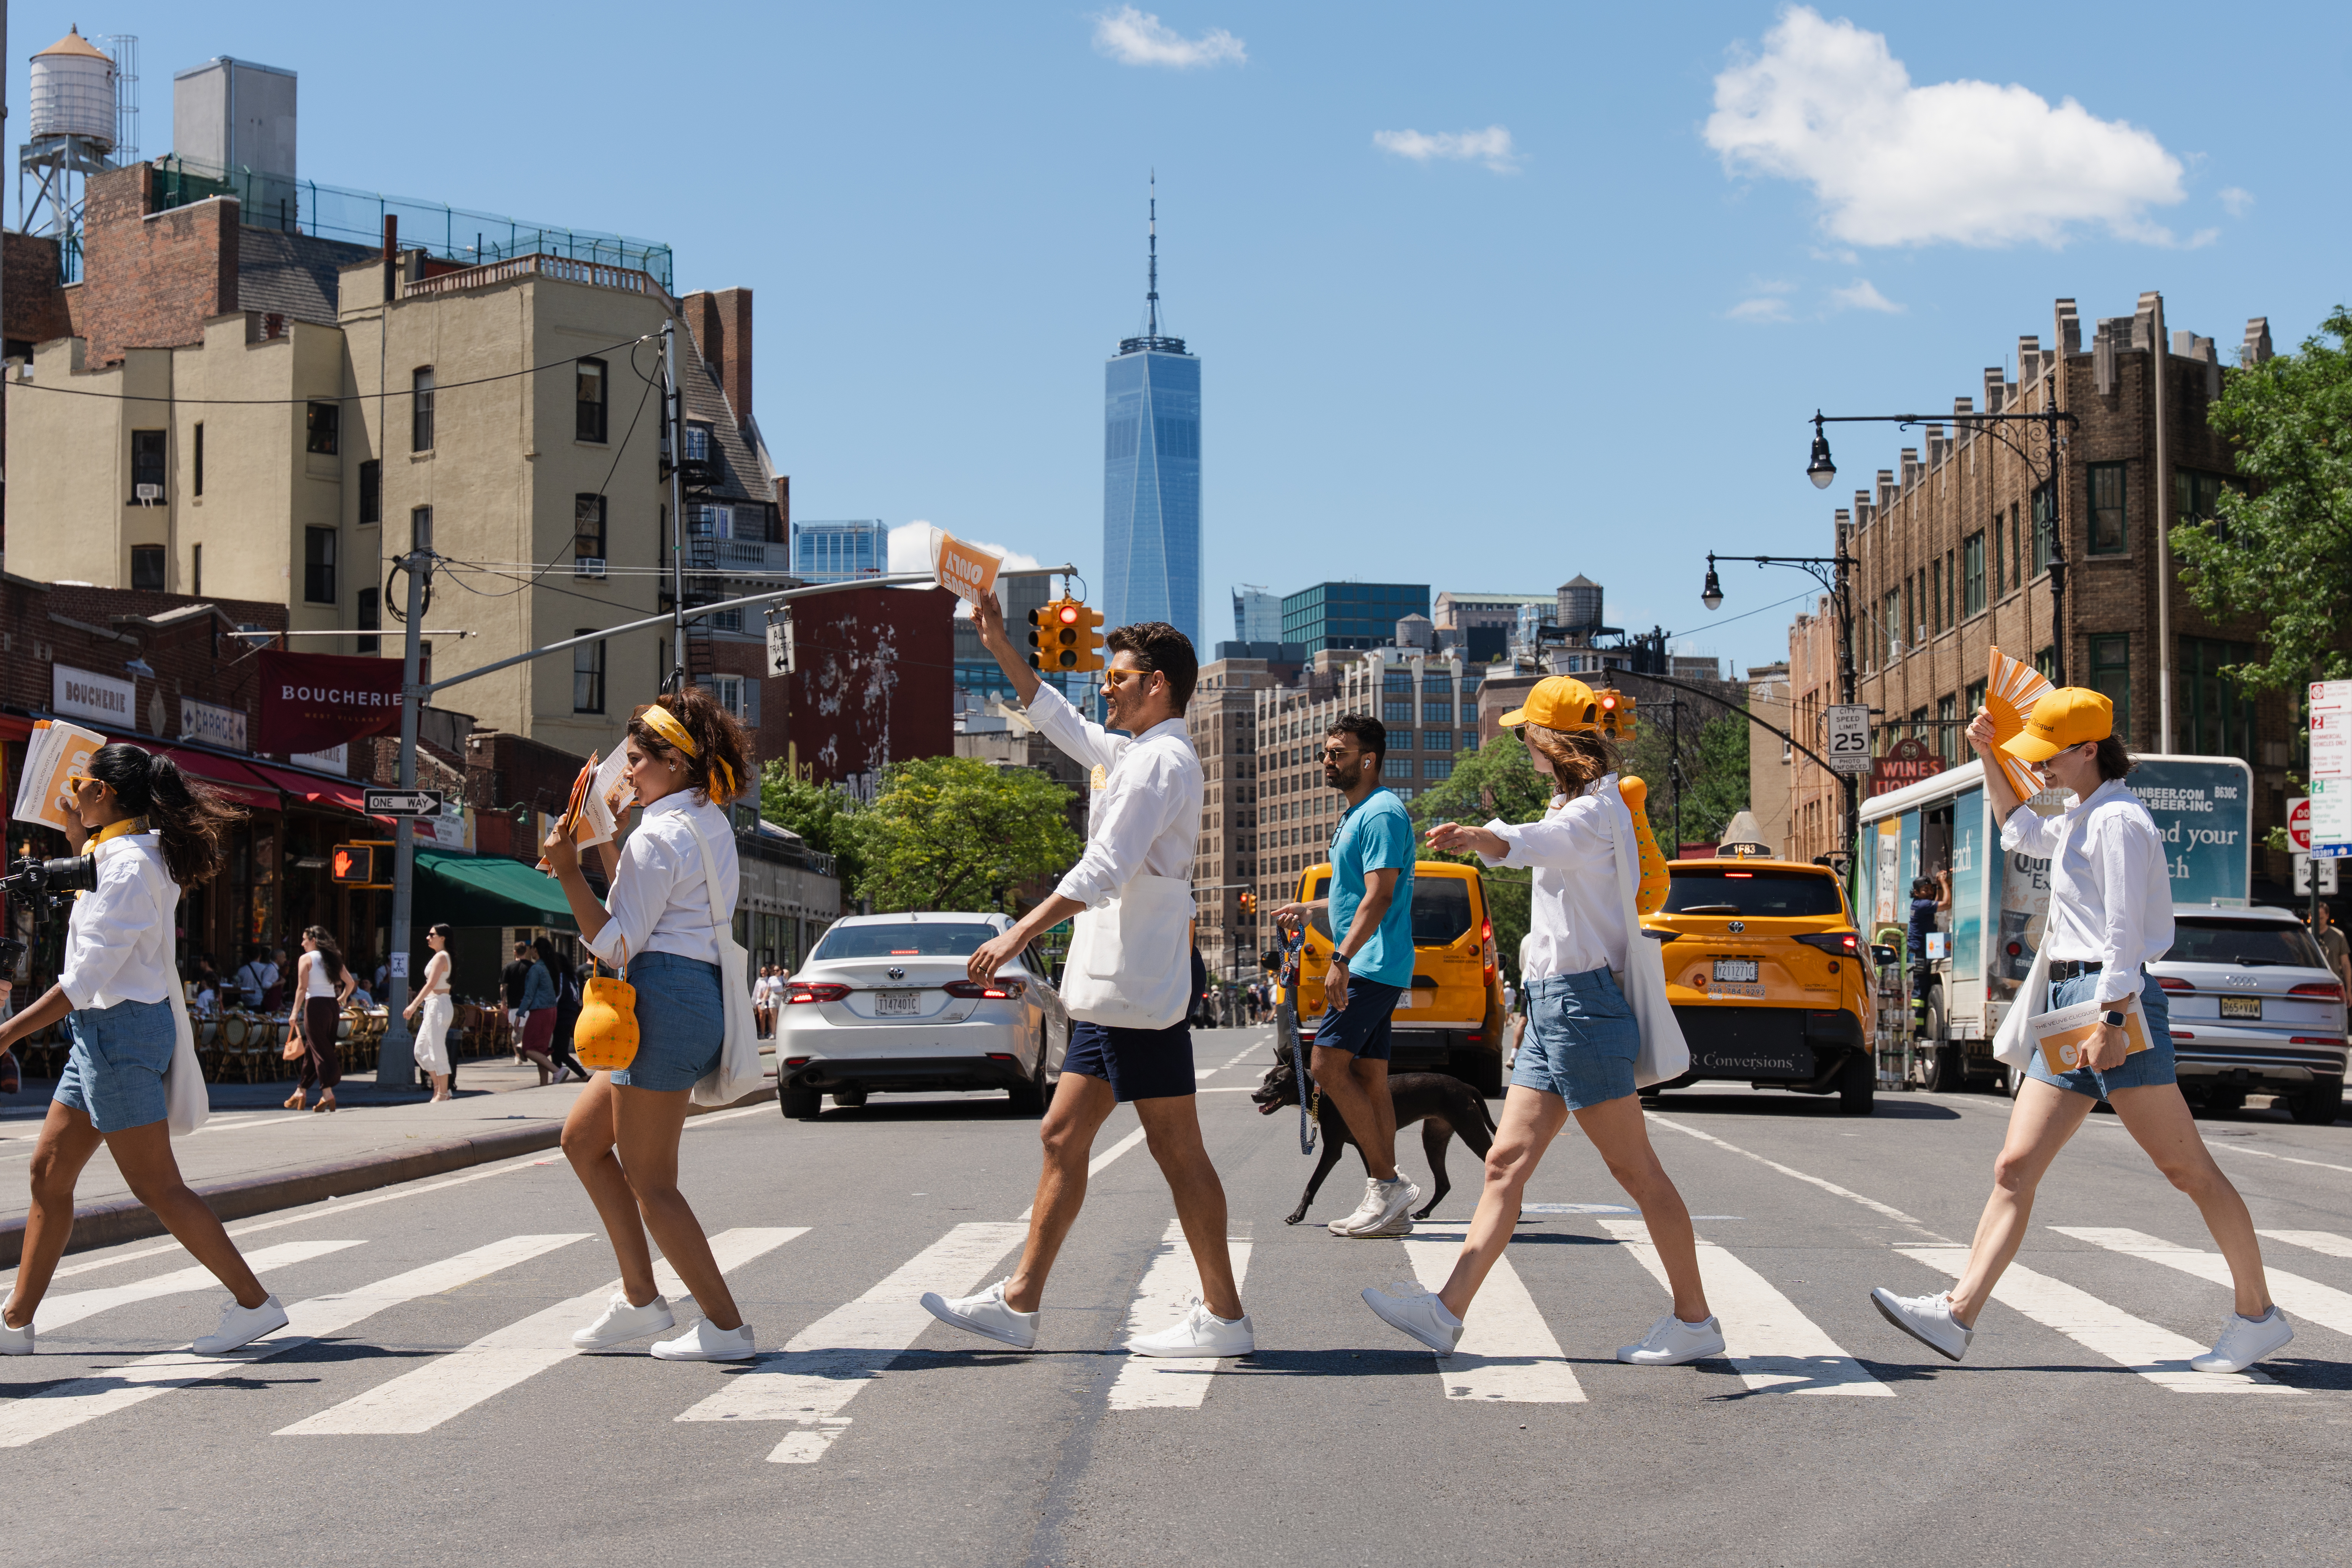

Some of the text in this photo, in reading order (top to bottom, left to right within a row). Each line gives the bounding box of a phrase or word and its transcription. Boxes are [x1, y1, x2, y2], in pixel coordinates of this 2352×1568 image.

[945, 550, 983, 585] ONLY
[774, 628, 786, 641] ALL
[769, 642, 792, 655] TRAFFIC
[66, 681, 125, 713] BOUCHERIE
[282, 685, 403, 706] BOUCHERIE
[2031, 717, 2054, 732] Clicquot
[2313, 716, 2322, 729] 2
[1835, 733, 1864, 751] 25
[39, 759, 50, 785] CLICQUOT
[48, 730, 64, 758] CHRONICLE
[1903, 746, 1917, 756] 98
[1882, 761, 1940, 777] WINES
[2215, 786, 2237, 799] B630C
[2314, 781, 2322, 793] 2
[373, 798, 429, 808] ONE WAY
[591, 802, 605, 836] CHRONICLE
[2297, 809, 2310, 818] DO
[2186, 829, 2238, 852] your
[2304, 856, 2327, 866] AL
[1718, 966, 1753, 977] Y211271C
[1708, 988, 1765, 996] 718-784-9292
[879, 998, 916, 1010] T147401C
[2048, 1017, 2068, 1027] VEUVE
[2068, 1009, 2098, 1020] CLICQUOT
[1704, 1054, 1793, 1068] Conversions
